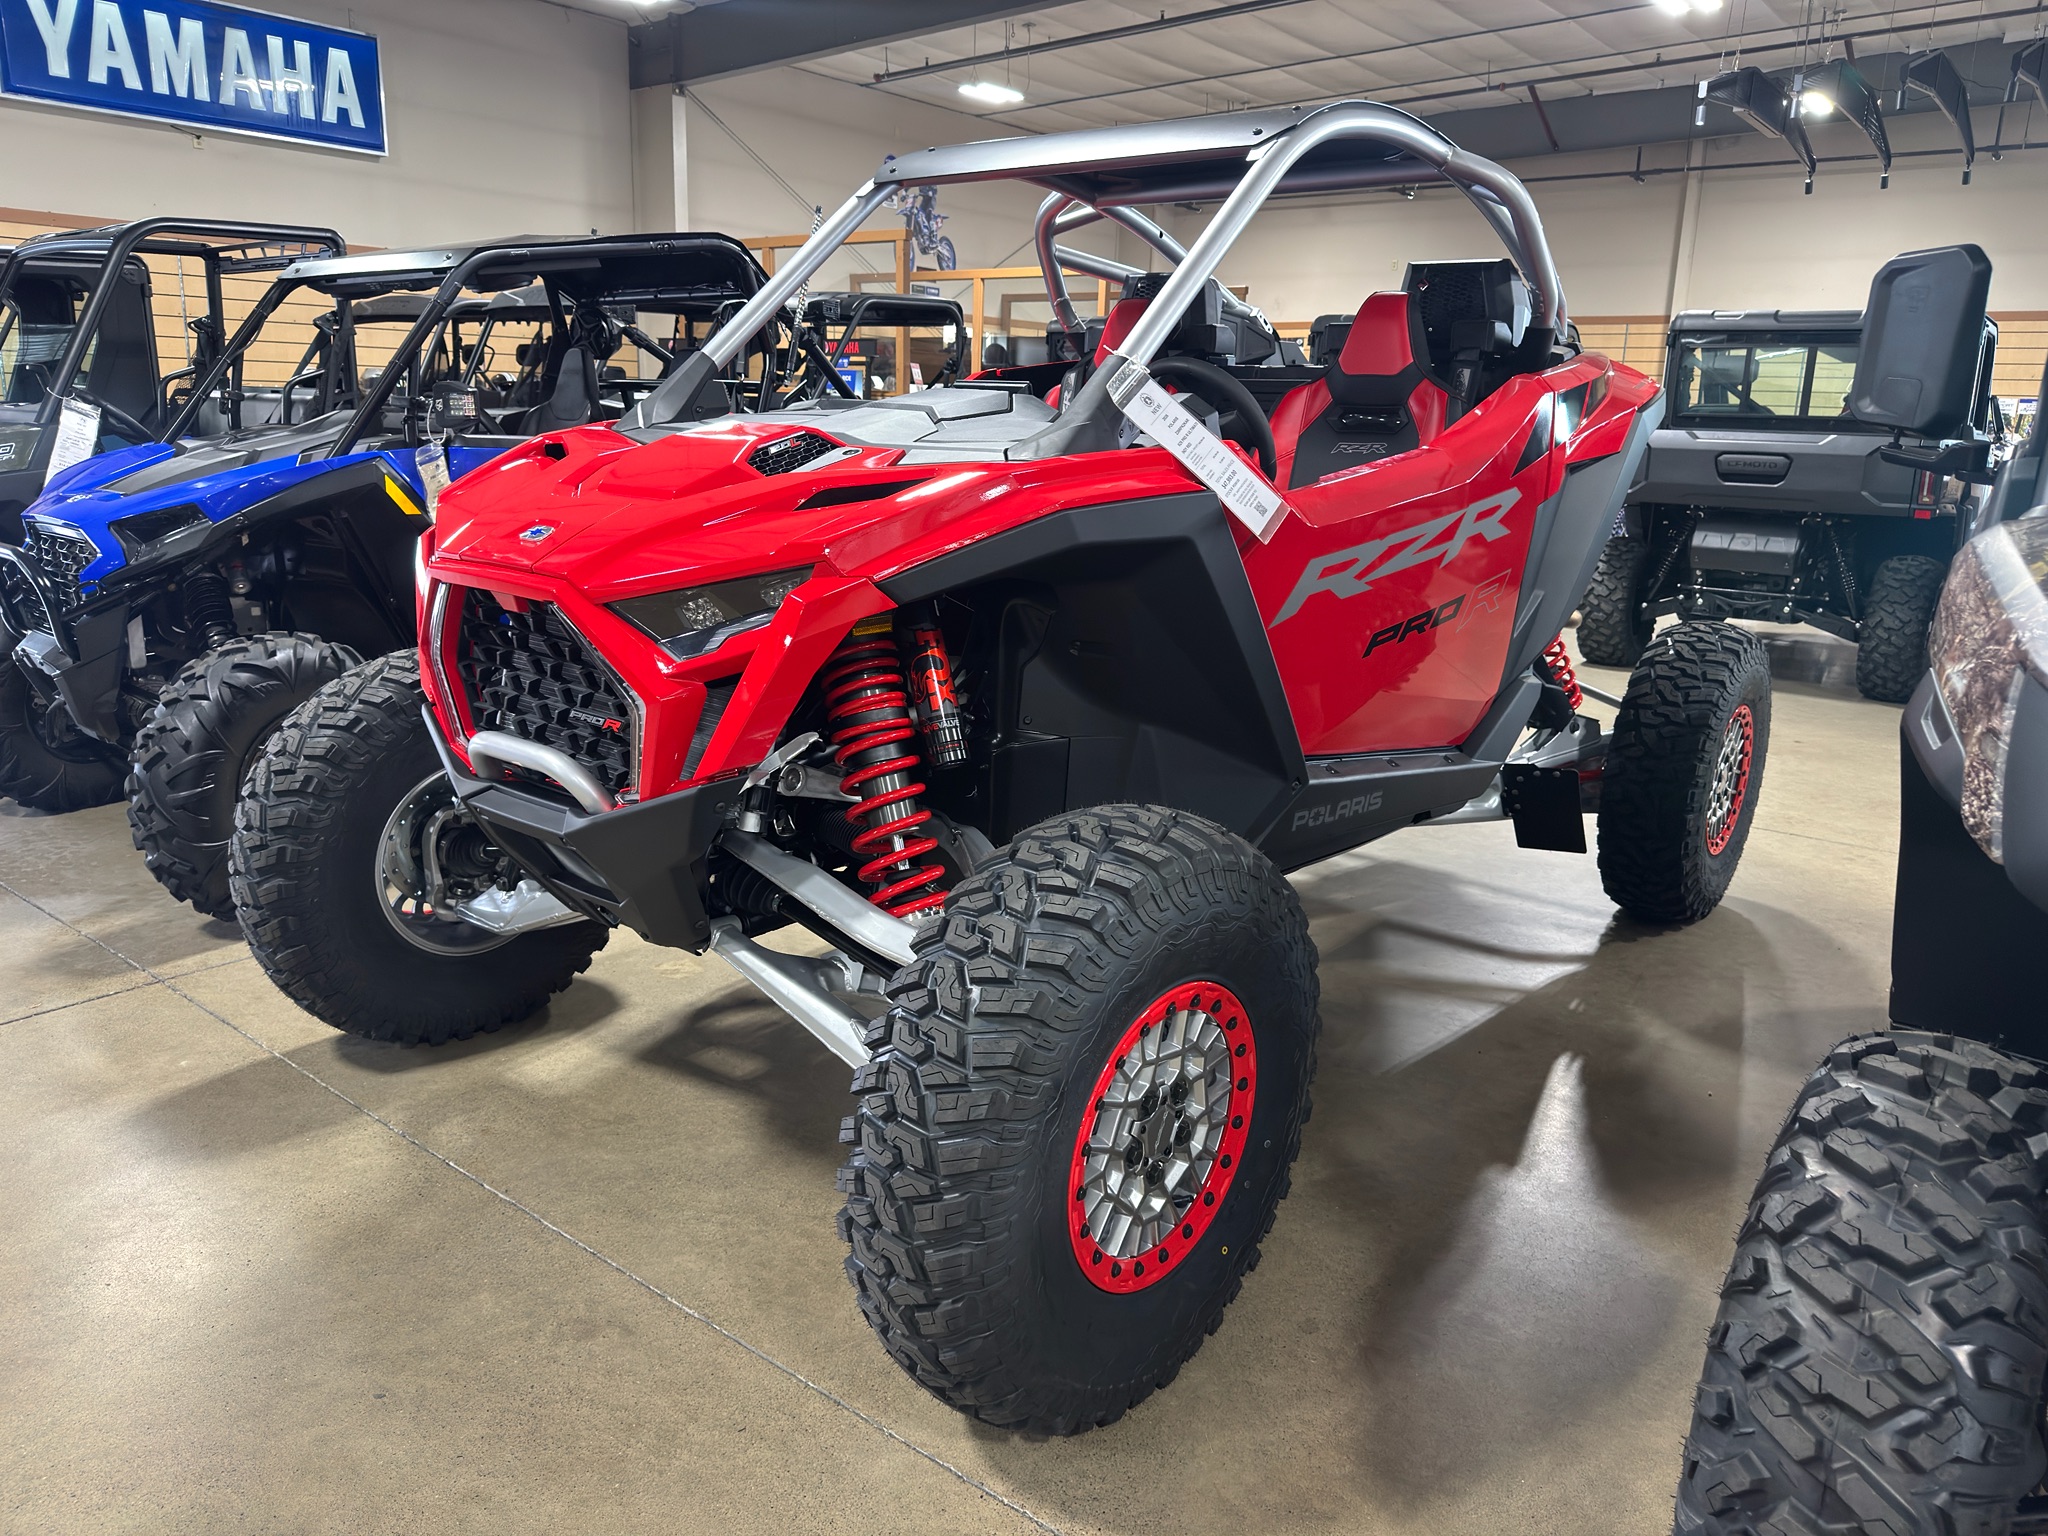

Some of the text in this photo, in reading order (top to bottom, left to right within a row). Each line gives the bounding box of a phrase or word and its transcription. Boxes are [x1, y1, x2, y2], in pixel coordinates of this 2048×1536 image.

[27, 0, 366, 129] YAMAHA
[828, 341, 860, 354] YAAHA
[1151, 402, 1162, 415] NEW
[1167, 416, 1178, 428] POLARIS
[1331, 442, 1388, 455] RZR
[1727, 460, 1778, 470] CFMOTO
[1268, 486, 1523, 630] RZR
[1362, 569, 1512, 659] PRO R
[912, 628, 959, 711] FOX
[569, 710, 622, 733] PRO R
[1291, 791, 1384, 832] POLARIS
